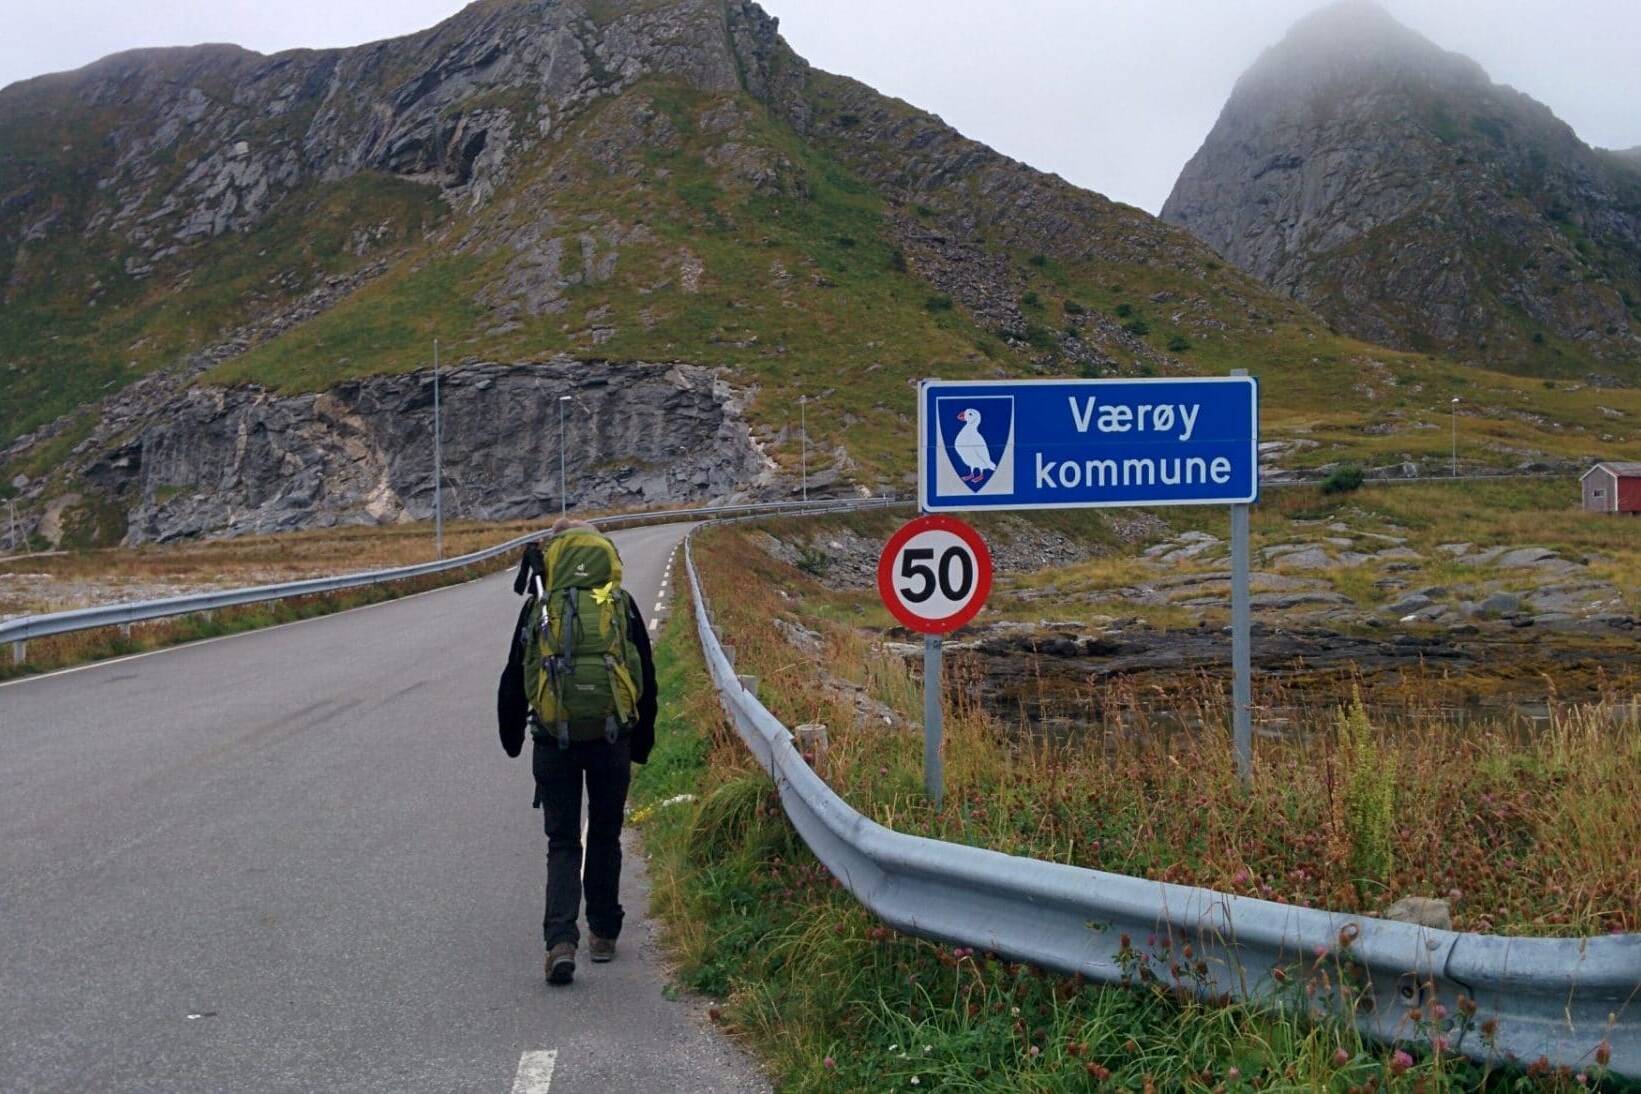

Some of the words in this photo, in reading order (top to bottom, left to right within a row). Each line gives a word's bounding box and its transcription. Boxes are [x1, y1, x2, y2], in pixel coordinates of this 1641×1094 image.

[1069, 396, 1200, 441] Værøy
[1036, 453, 1231, 488] kommune
[900, 546, 973, 603] 50
